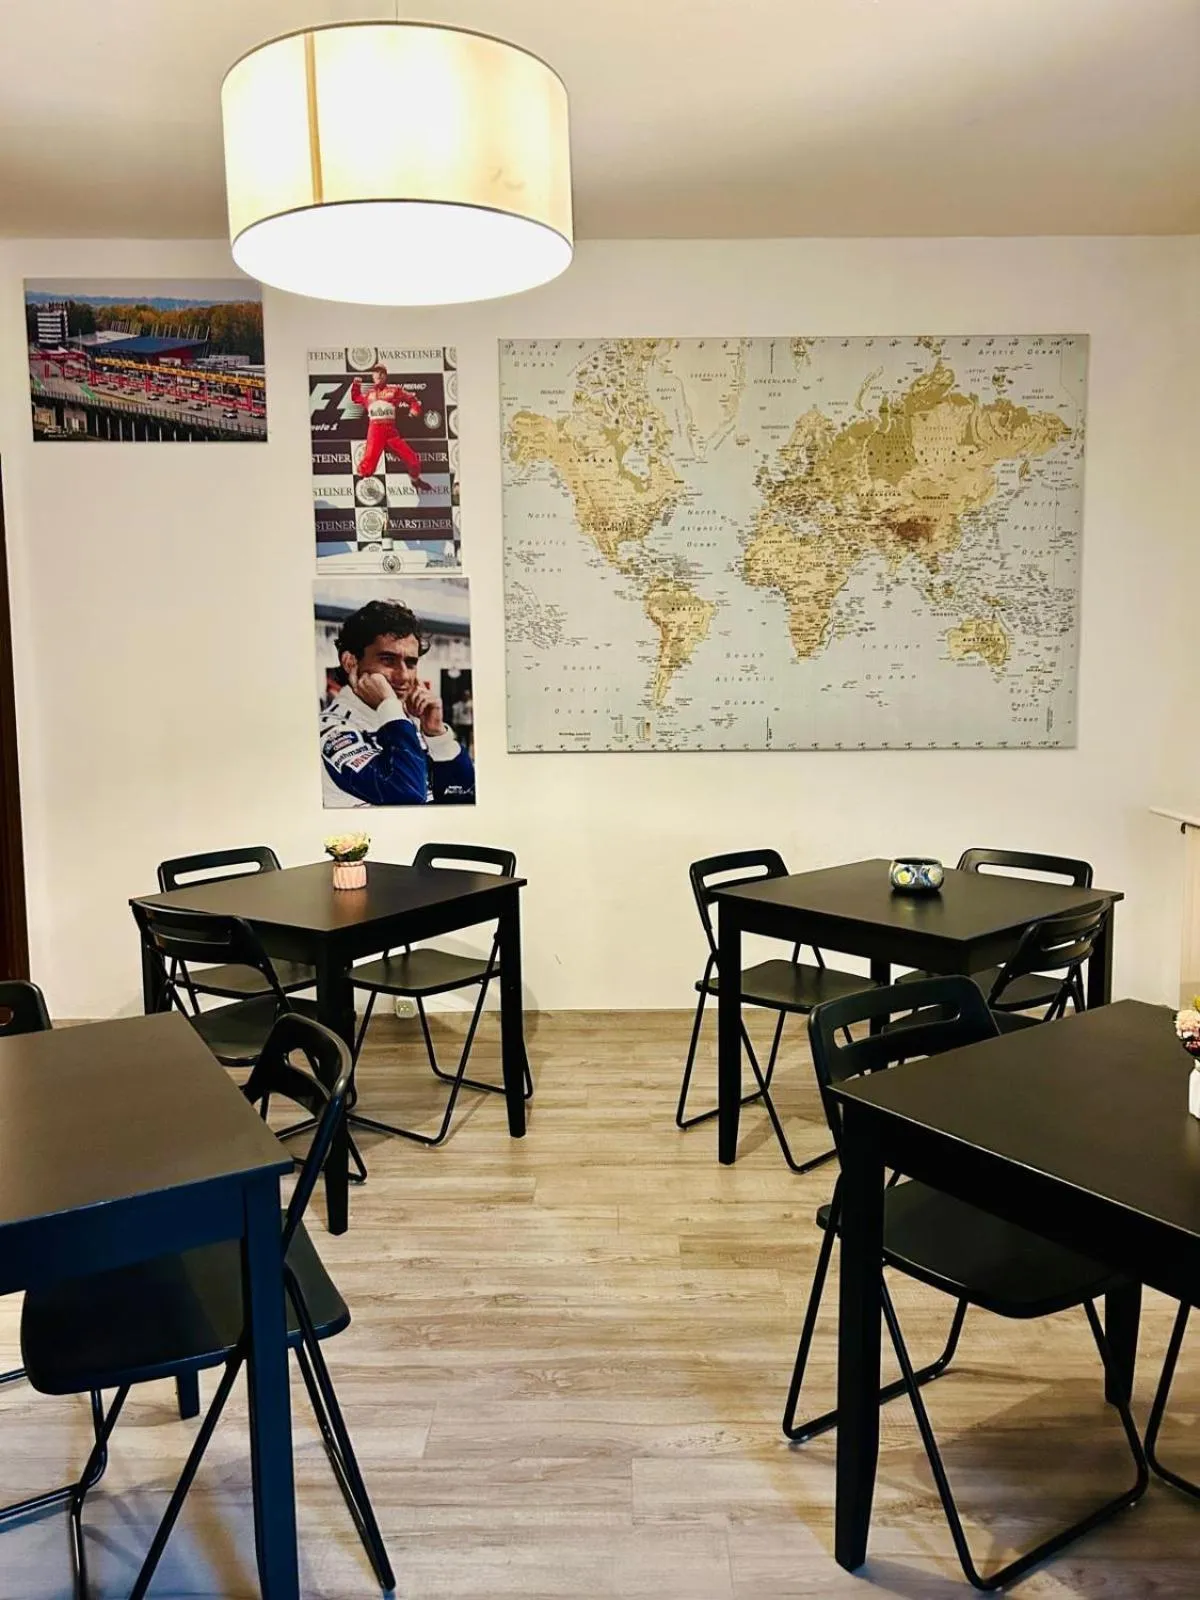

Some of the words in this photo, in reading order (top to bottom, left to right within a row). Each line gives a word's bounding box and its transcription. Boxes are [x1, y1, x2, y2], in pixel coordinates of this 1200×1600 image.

[379, 350, 442, 360] WARSTEINER
[311, 453, 352, 463] STEINER
[389, 519, 452, 529] WARSTEINER
